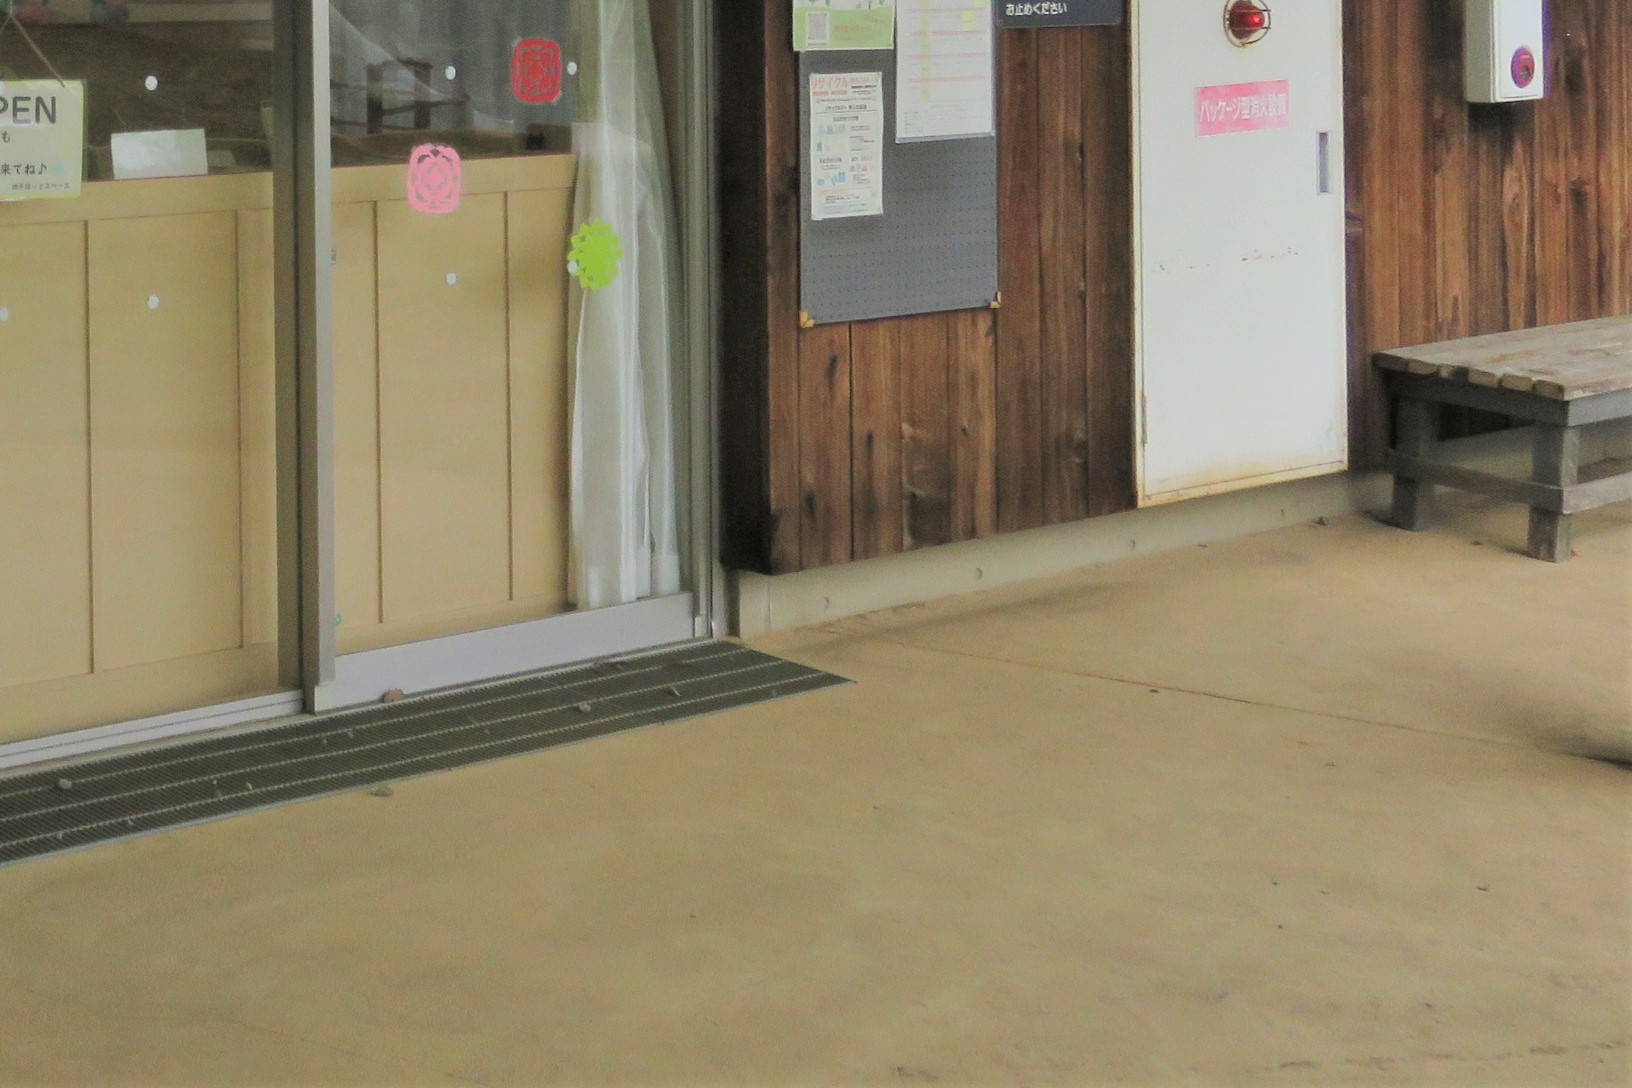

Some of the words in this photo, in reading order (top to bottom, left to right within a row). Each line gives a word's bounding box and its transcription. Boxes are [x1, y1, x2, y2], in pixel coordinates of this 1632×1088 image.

[1005, 1, 1068, 16] お止めください
